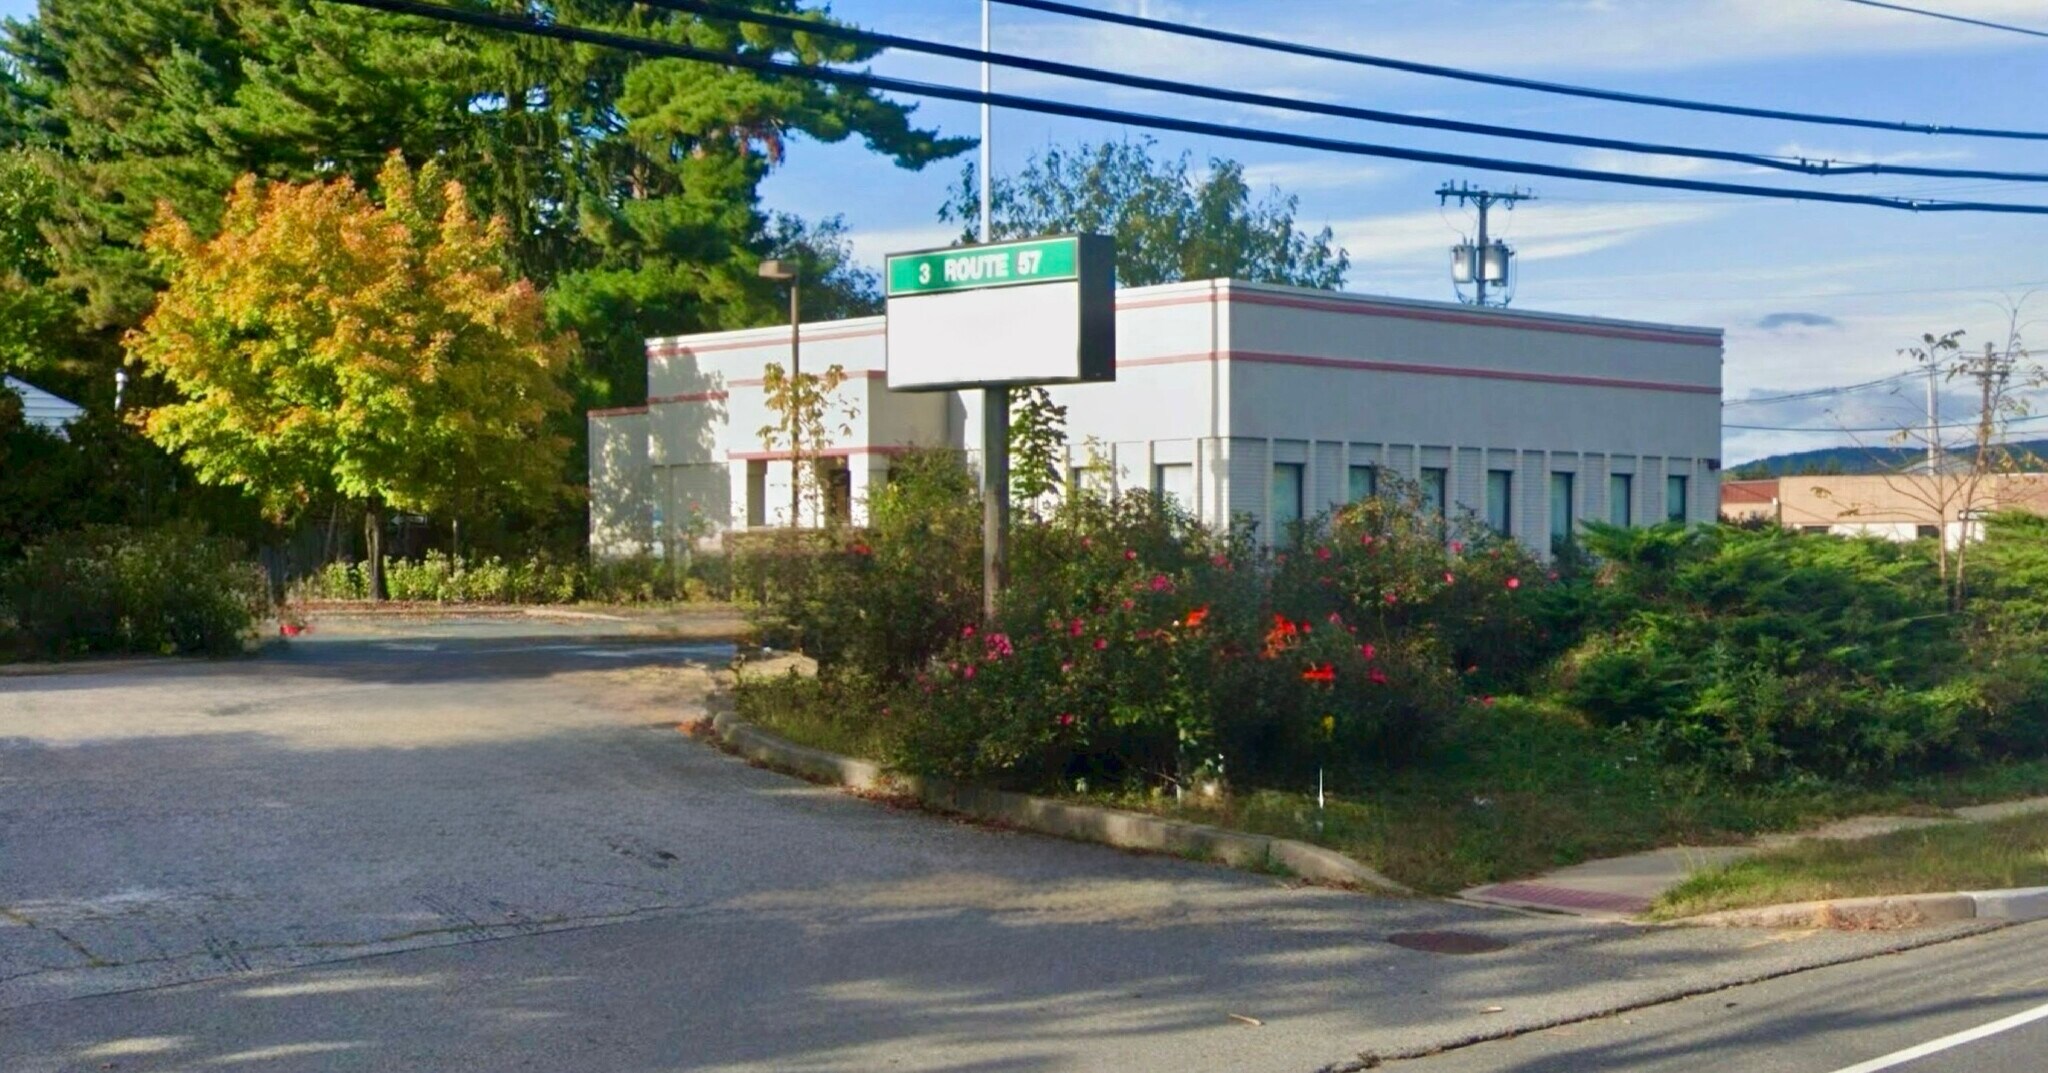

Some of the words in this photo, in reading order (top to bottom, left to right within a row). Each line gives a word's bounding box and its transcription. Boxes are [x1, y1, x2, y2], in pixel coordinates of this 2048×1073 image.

[918, 262, 931, 285] 3
[944, 252, 1010, 283] ROUTE
[1017, 250, 1043, 276] 57
